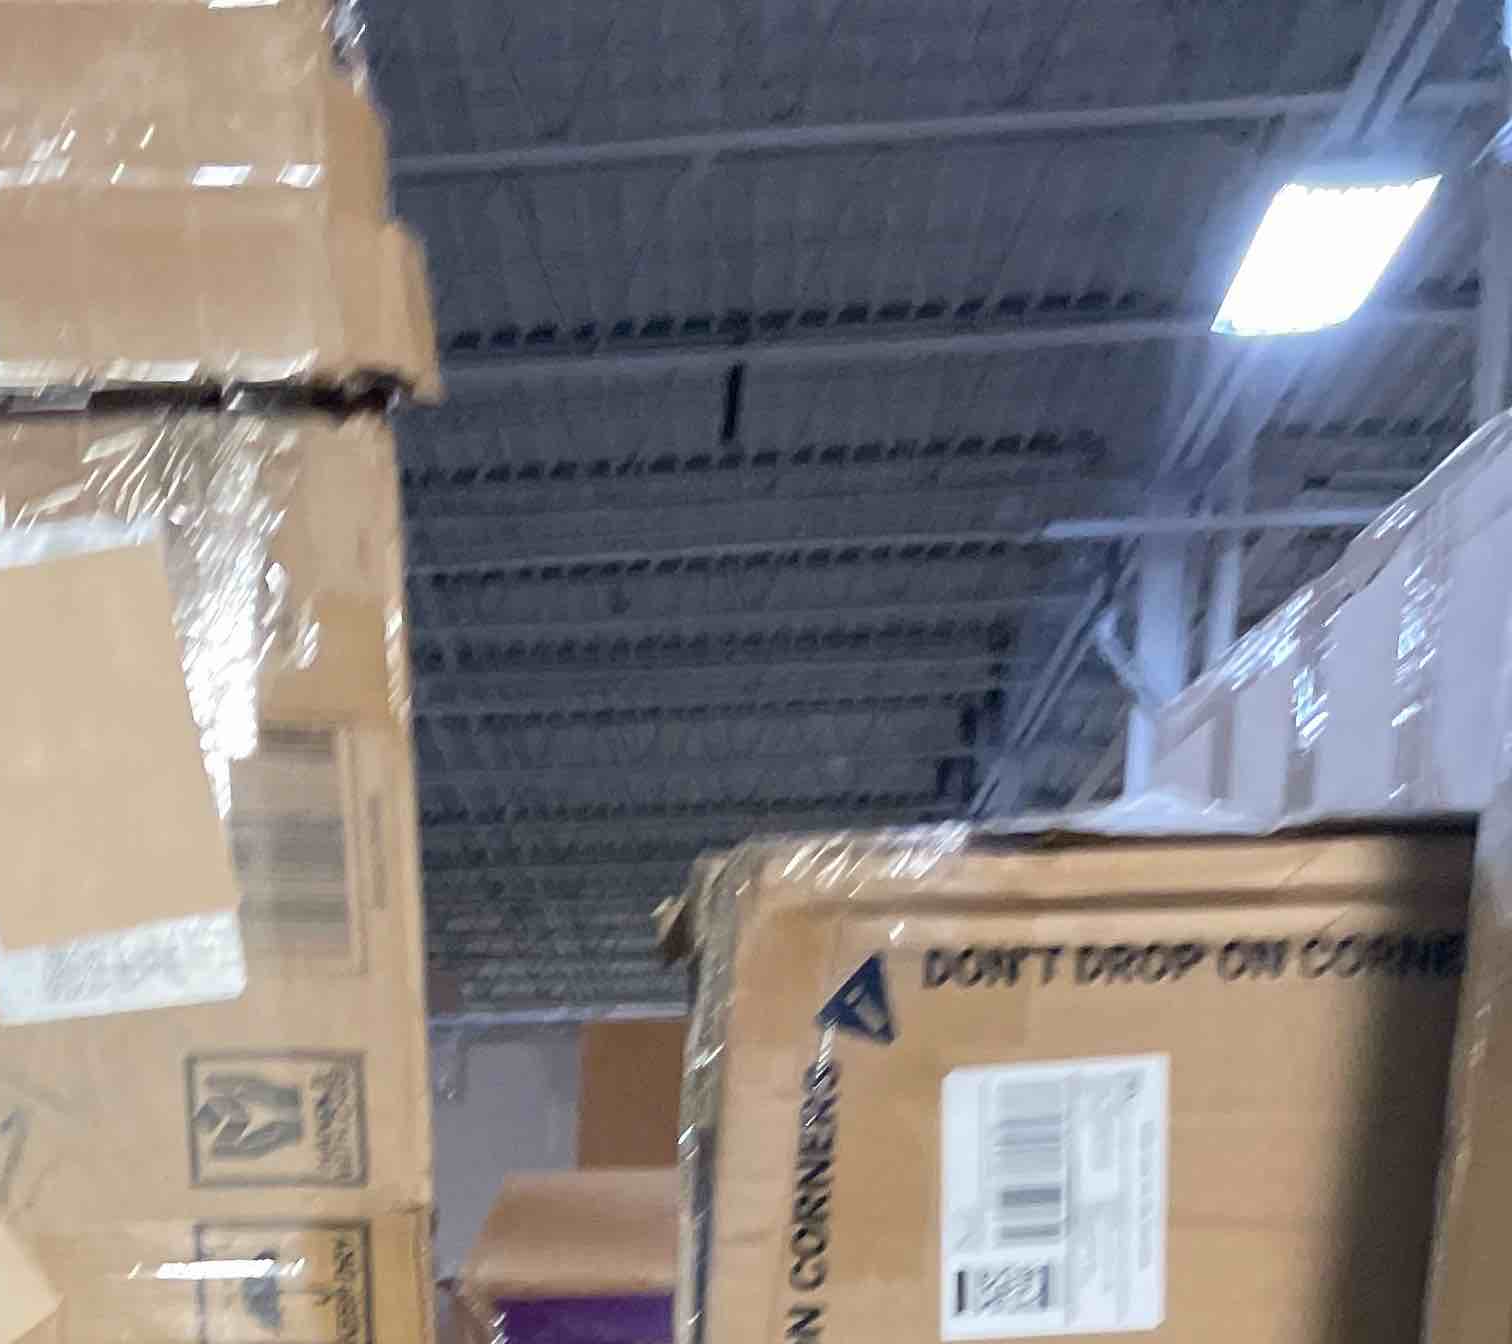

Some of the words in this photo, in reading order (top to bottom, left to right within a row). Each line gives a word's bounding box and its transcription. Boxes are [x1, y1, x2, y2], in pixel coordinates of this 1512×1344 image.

[921, 943, 1065, 990] DON'T
[1075, 940, 1206, 988] DROP
[1217, 936, 1291, 983] ON
